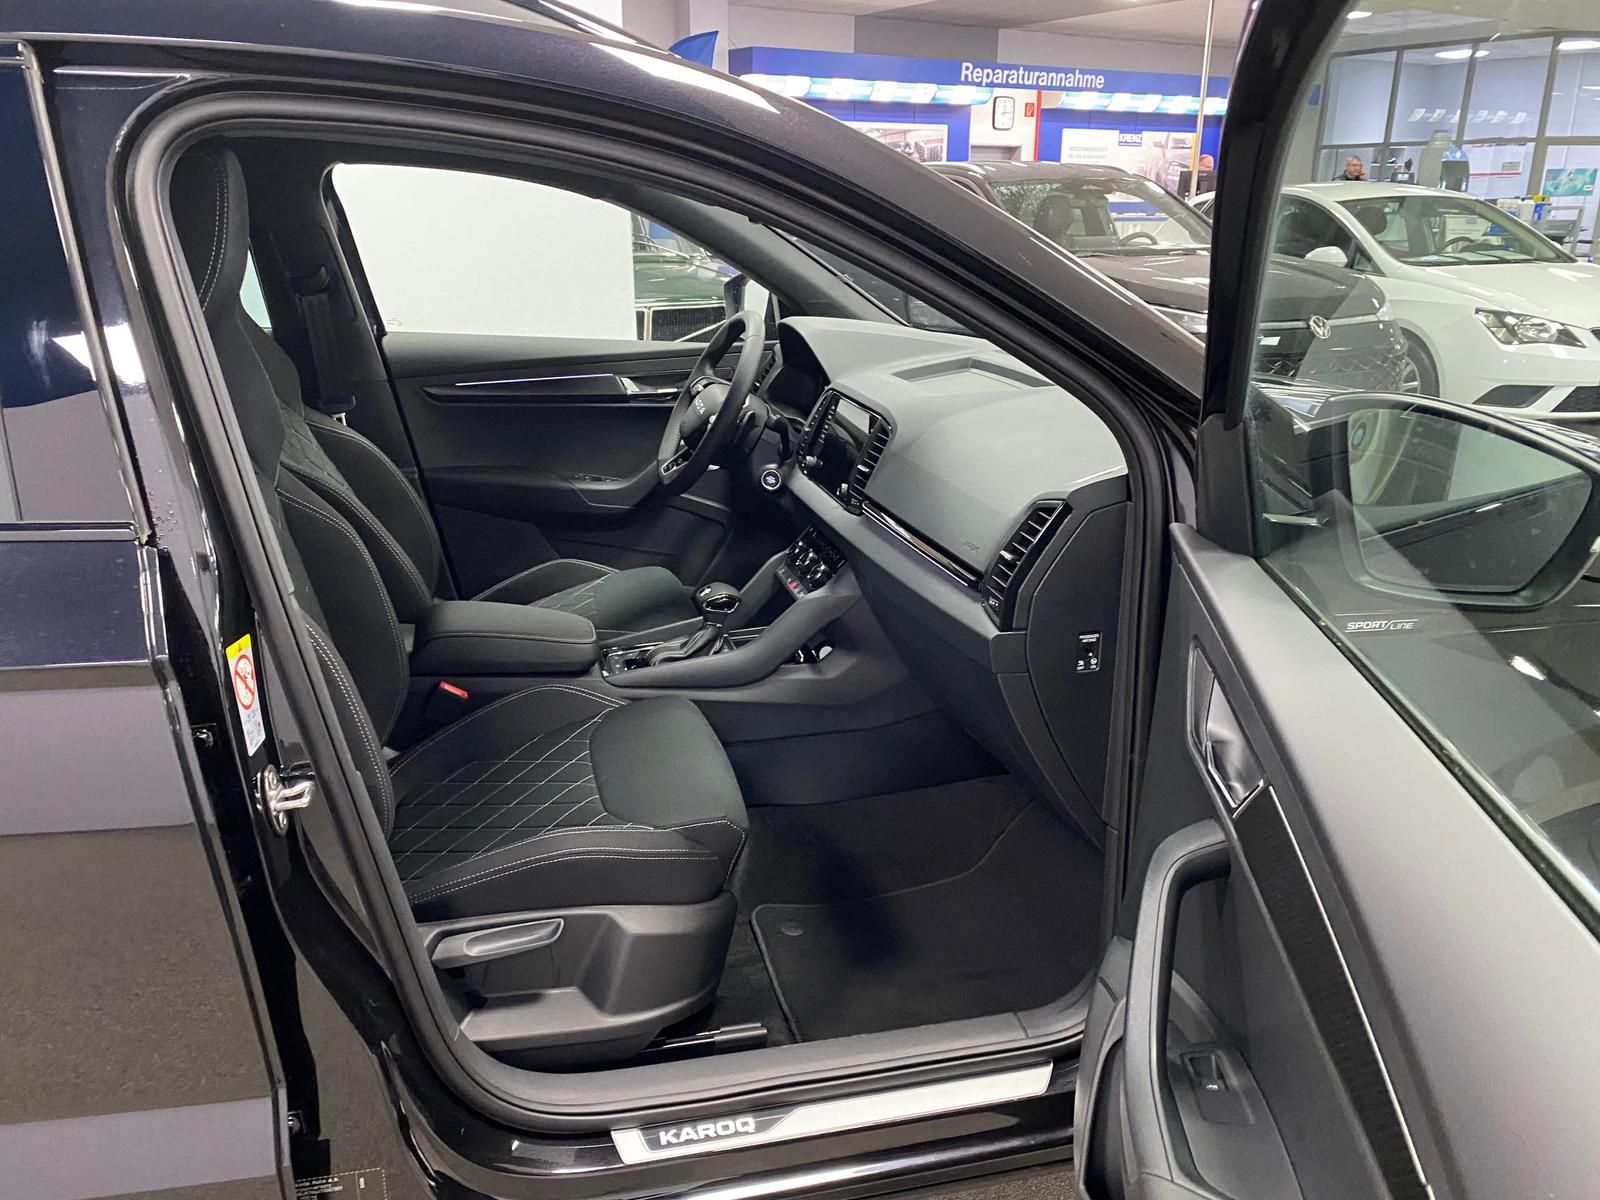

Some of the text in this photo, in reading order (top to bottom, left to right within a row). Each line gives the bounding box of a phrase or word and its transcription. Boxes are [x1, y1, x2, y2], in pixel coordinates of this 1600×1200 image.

[960, 62, 1105, 89] Reparaturannahme
[1120, 133, 1143, 143] KRENZ
[1346, 621, 1389, 630] SPORT
[658, 1117, 756, 1146] KAROQ
